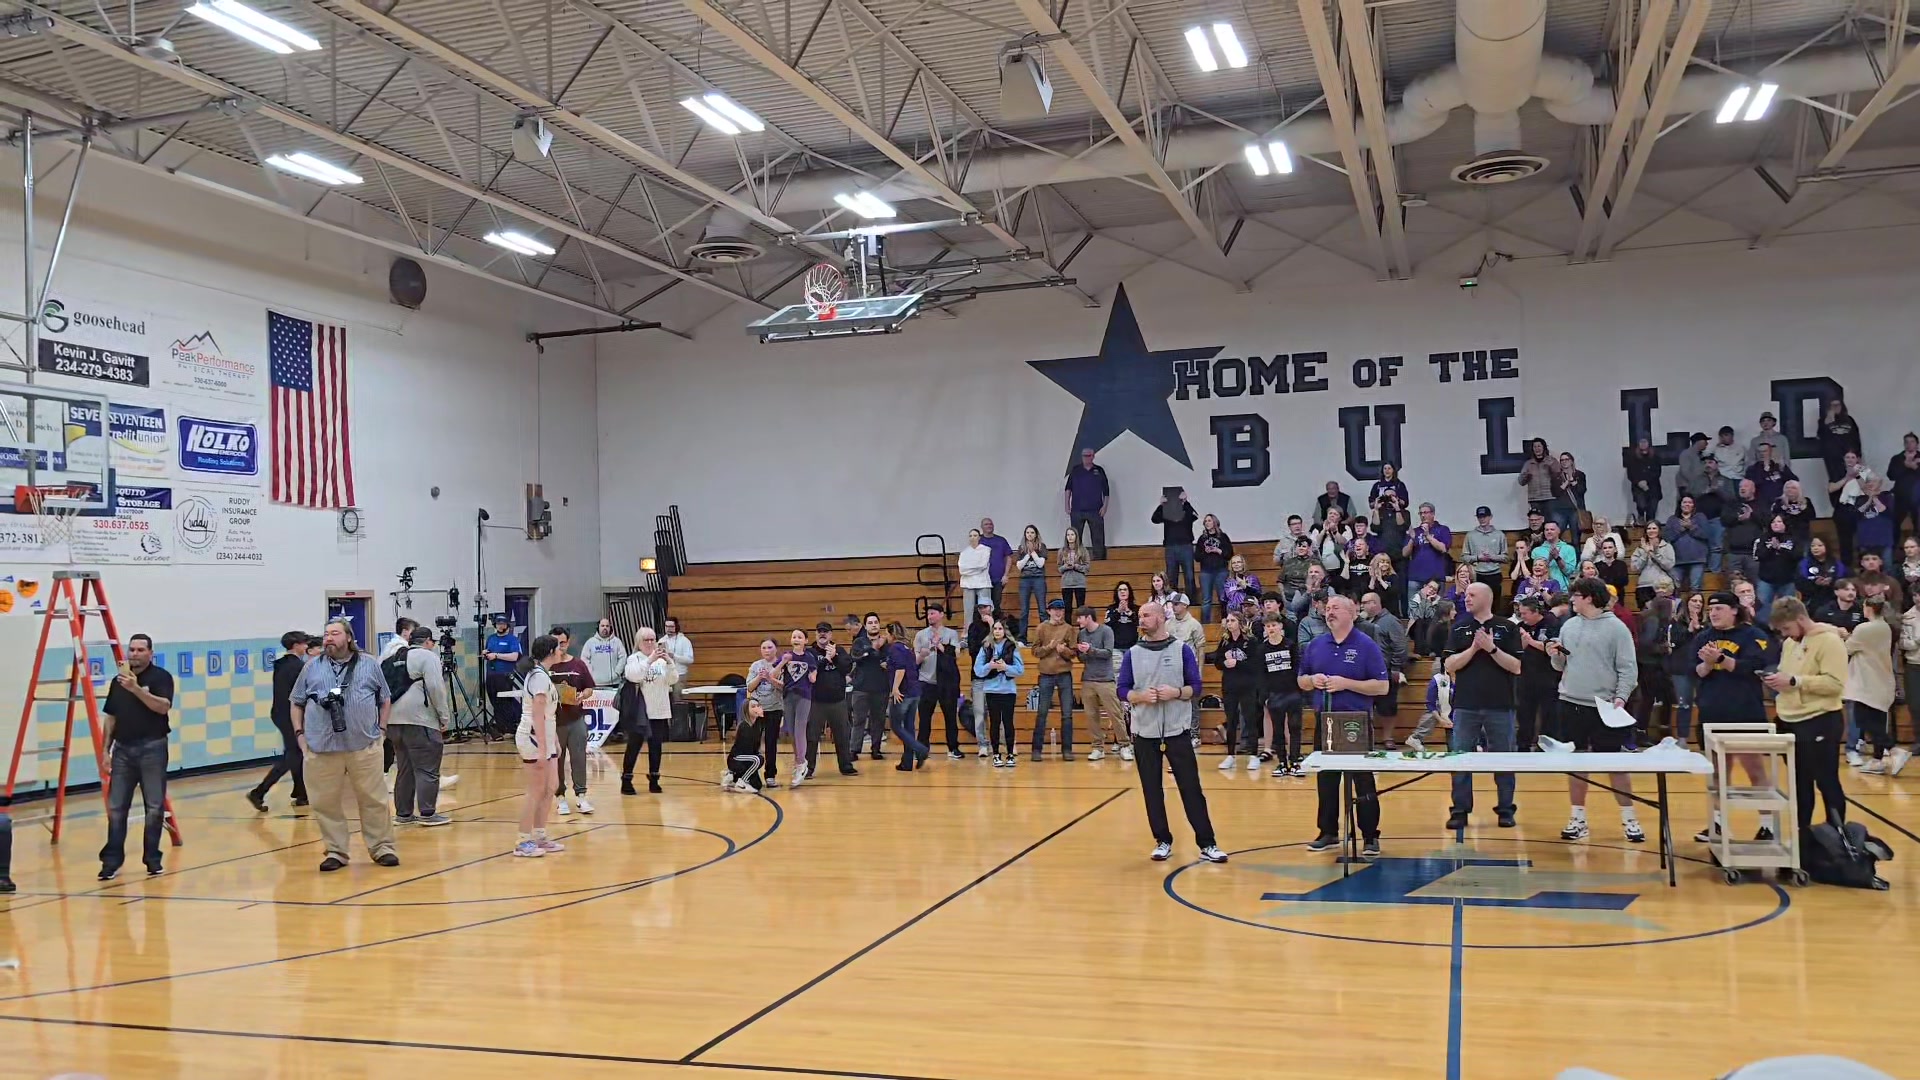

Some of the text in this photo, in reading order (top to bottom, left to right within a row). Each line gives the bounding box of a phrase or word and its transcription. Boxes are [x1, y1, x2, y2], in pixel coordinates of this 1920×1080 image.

[74, 312, 145, 335] goosehead
[53, 343, 135, 368] Kevin J. Gavitt
[55, 358, 133, 381] 234-279-4383
[1173, 348, 1519, 400] HOME OF THE
[70, 406, 101, 421] SEVE
[109, 412, 163, 429] SEVENTEEN
[186, 424, 250, 452] HOLKO
[118, 497, 161, 508] STORAGE
[229, 497, 250, 505] RUDDY
[222, 507, 257, 516] INSURANCE
[93, 520, 149, 530] 330.637.0525
[216, 552, 233, 560] (234)
